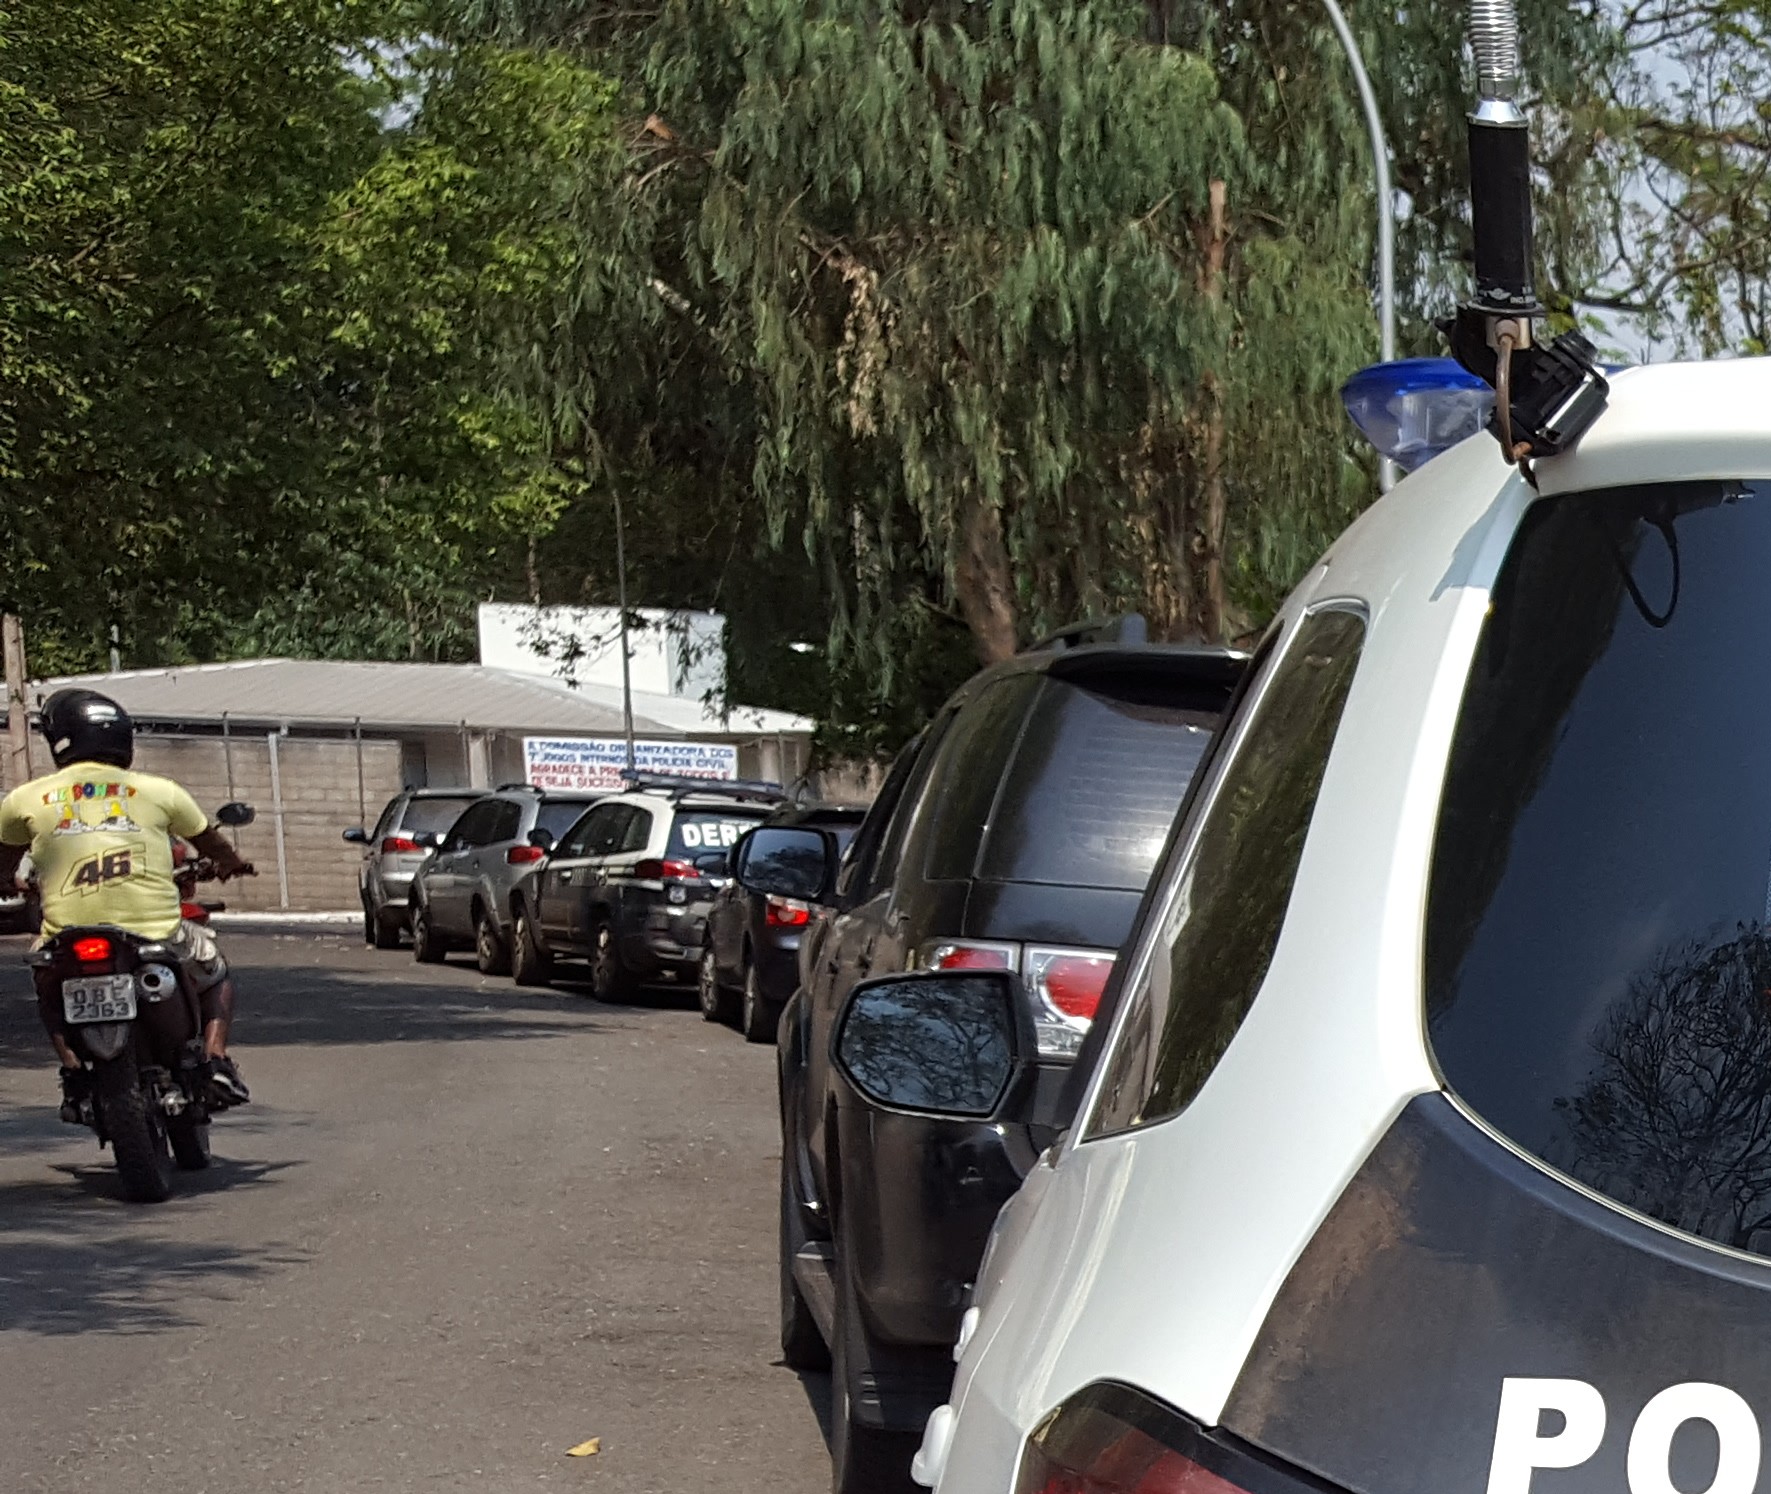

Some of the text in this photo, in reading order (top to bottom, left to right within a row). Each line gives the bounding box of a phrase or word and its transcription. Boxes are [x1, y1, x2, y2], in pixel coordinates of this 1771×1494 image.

[609, 744, 705, 757] ORANIZADORA
[681, 822, 748, 848] DER
[72, 848, 134, 889] 46
